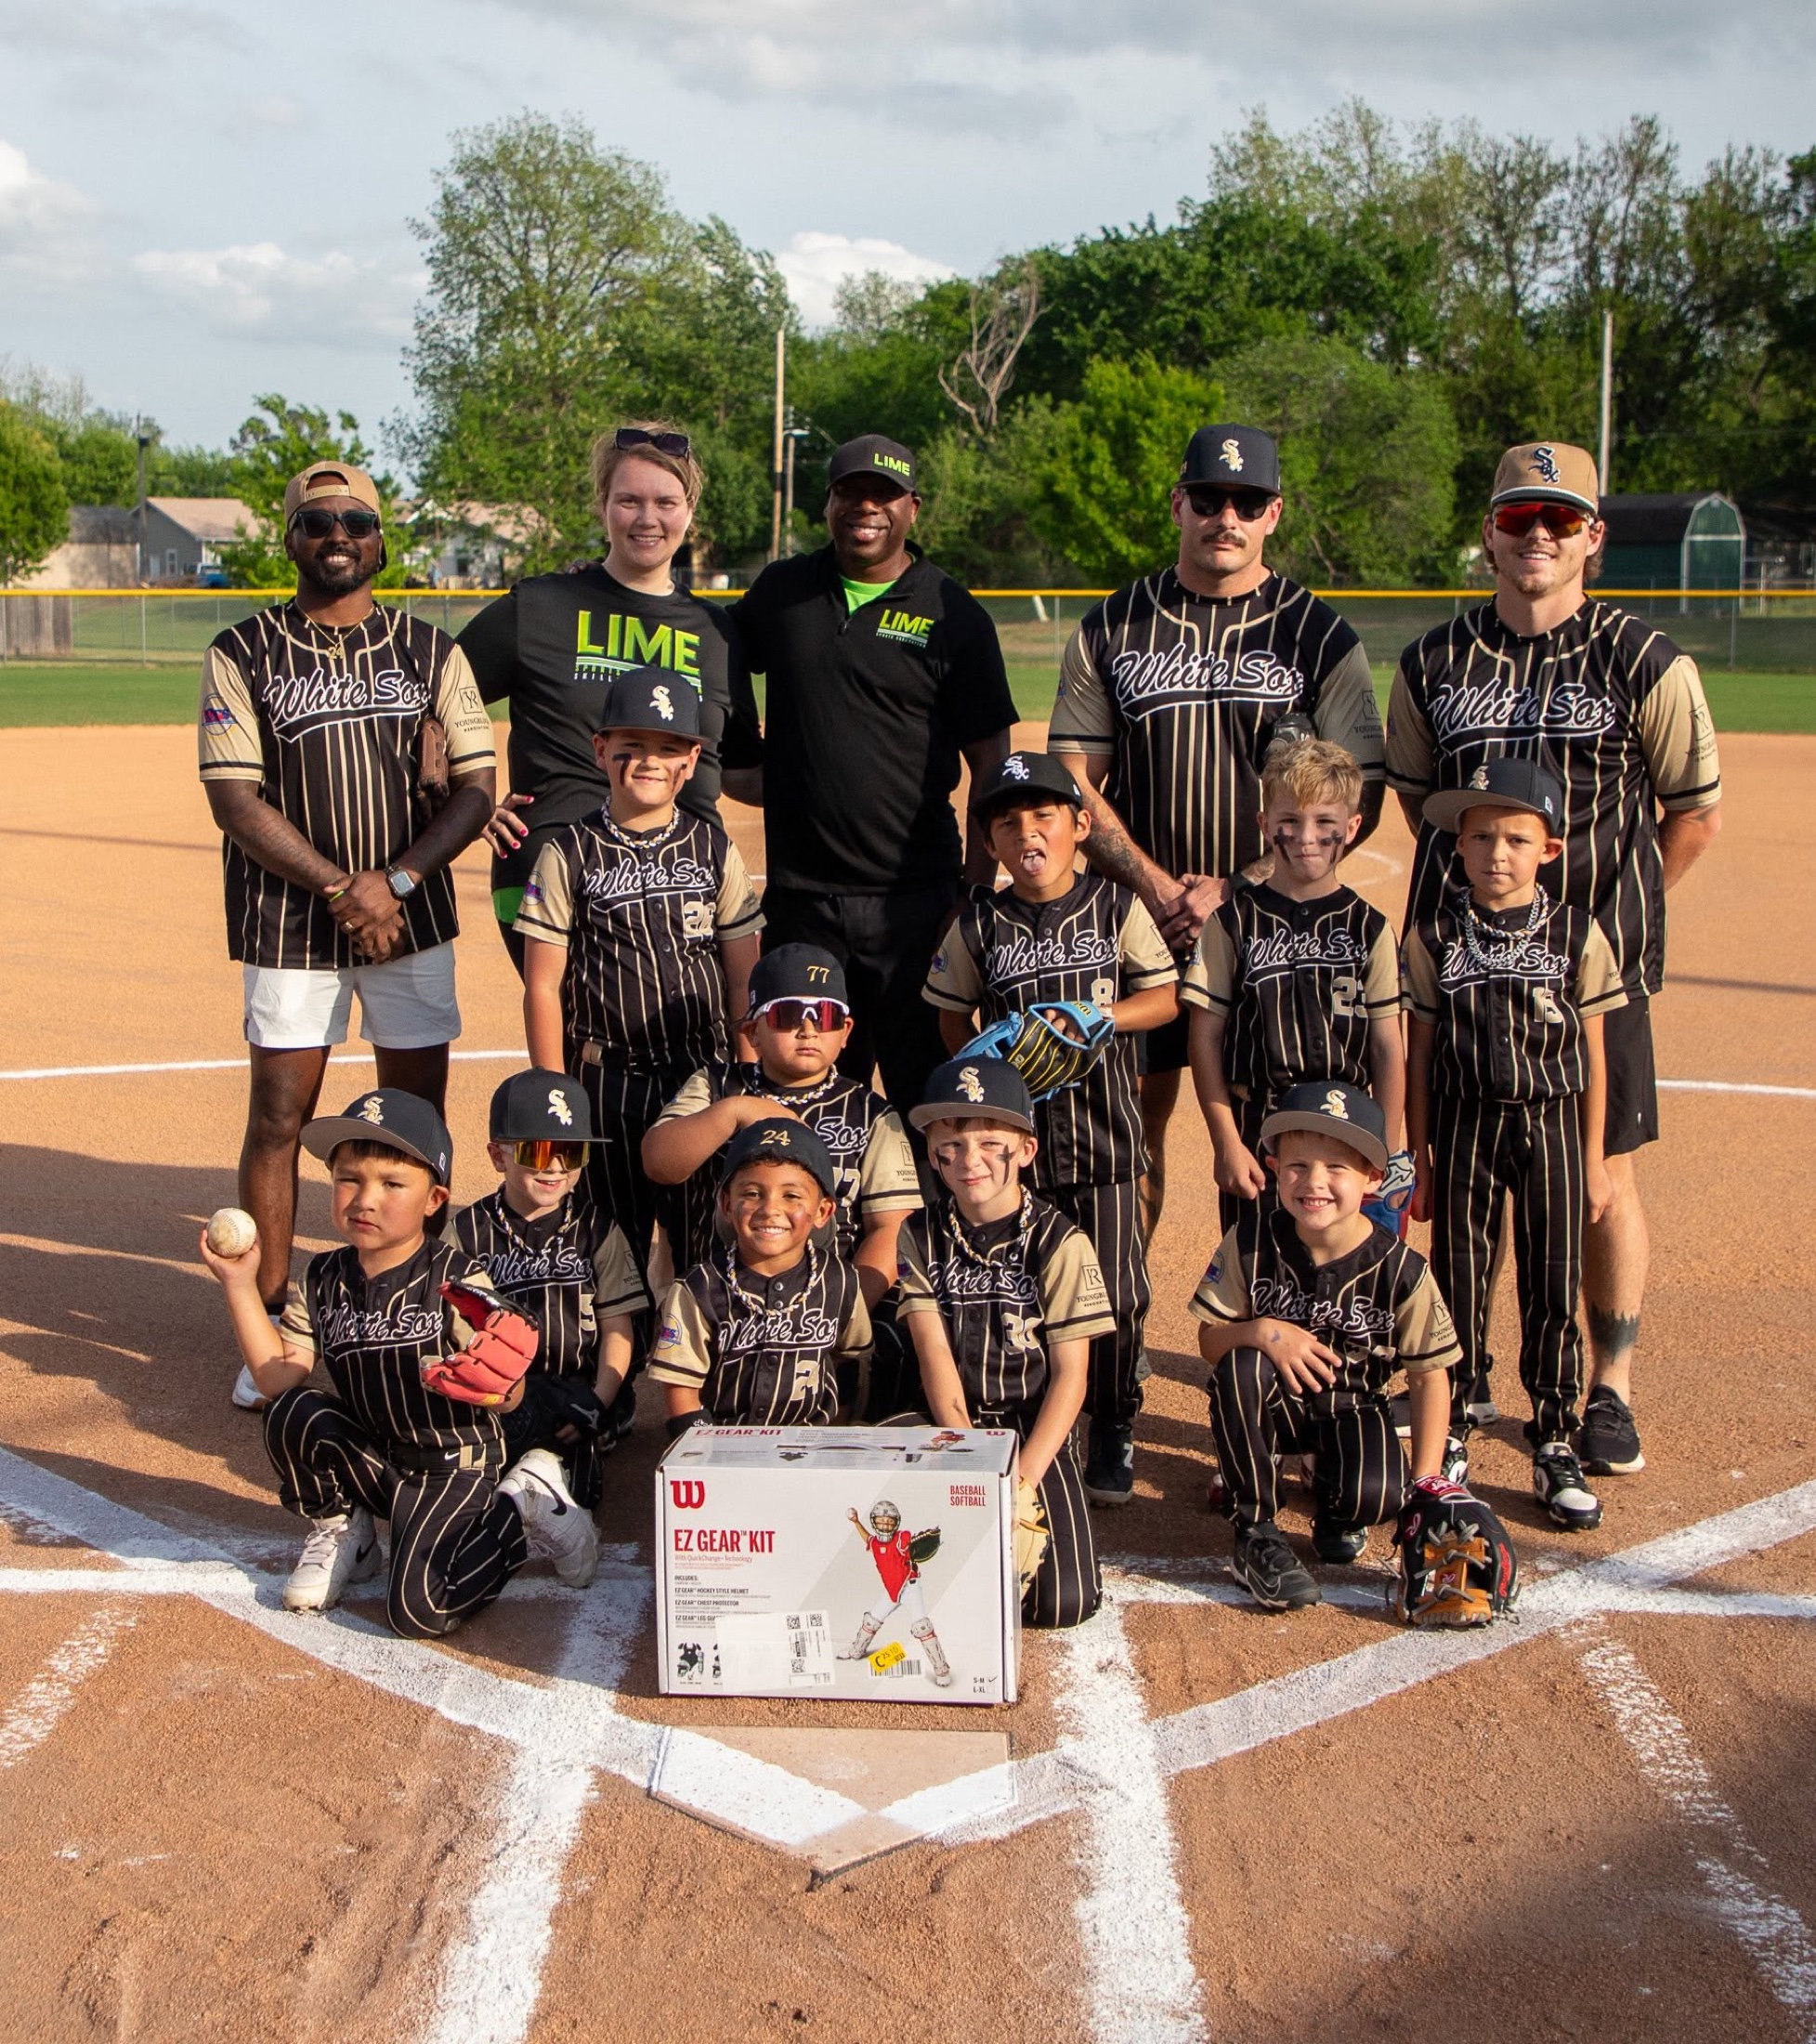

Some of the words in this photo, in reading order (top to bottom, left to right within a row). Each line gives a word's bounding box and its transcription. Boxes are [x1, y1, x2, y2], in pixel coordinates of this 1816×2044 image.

[874, 453, 910, 477] LIME
[880, 609, 934, 640] LIME
[328, 648, 345, 661] 24
[577, 609, 700, 676] LIME
[1113, 643, 1229, 701] White
[1232, 650, 1304, 695] Sox
[262, 668, 368, 721] White
[1427, 677, 1542, 737] White
[1541, 683, 1616, 728] Sox
[583, 858, 669, 898] White
[986, 936, 1065, 981] White
[1068, 929, 1118, 963] Sox
[1241, 927, 1321, 971] White
[1517, 942, 1570, 974] Sox
[807, 966, 830, 984] 77
[1091, 978, 1114, 1005] 8
[760, 1130, 790, 1146] 24
[815, 1117, 869, 1149] Sox
[477, 1247, 551, 1286] White
[391, 1304, 444, 1339] Sox
[1344, 1296, 1395, 1330] Sox
[718, 1312, 792, 1353] White
[950, 1485, 986, 1496] BASEBALL
[950, 1496, 986, 1506] SOFTBALL
[674, 1529, 693, 1552] EZ
[749, 1530, 776, 1553] KIT
